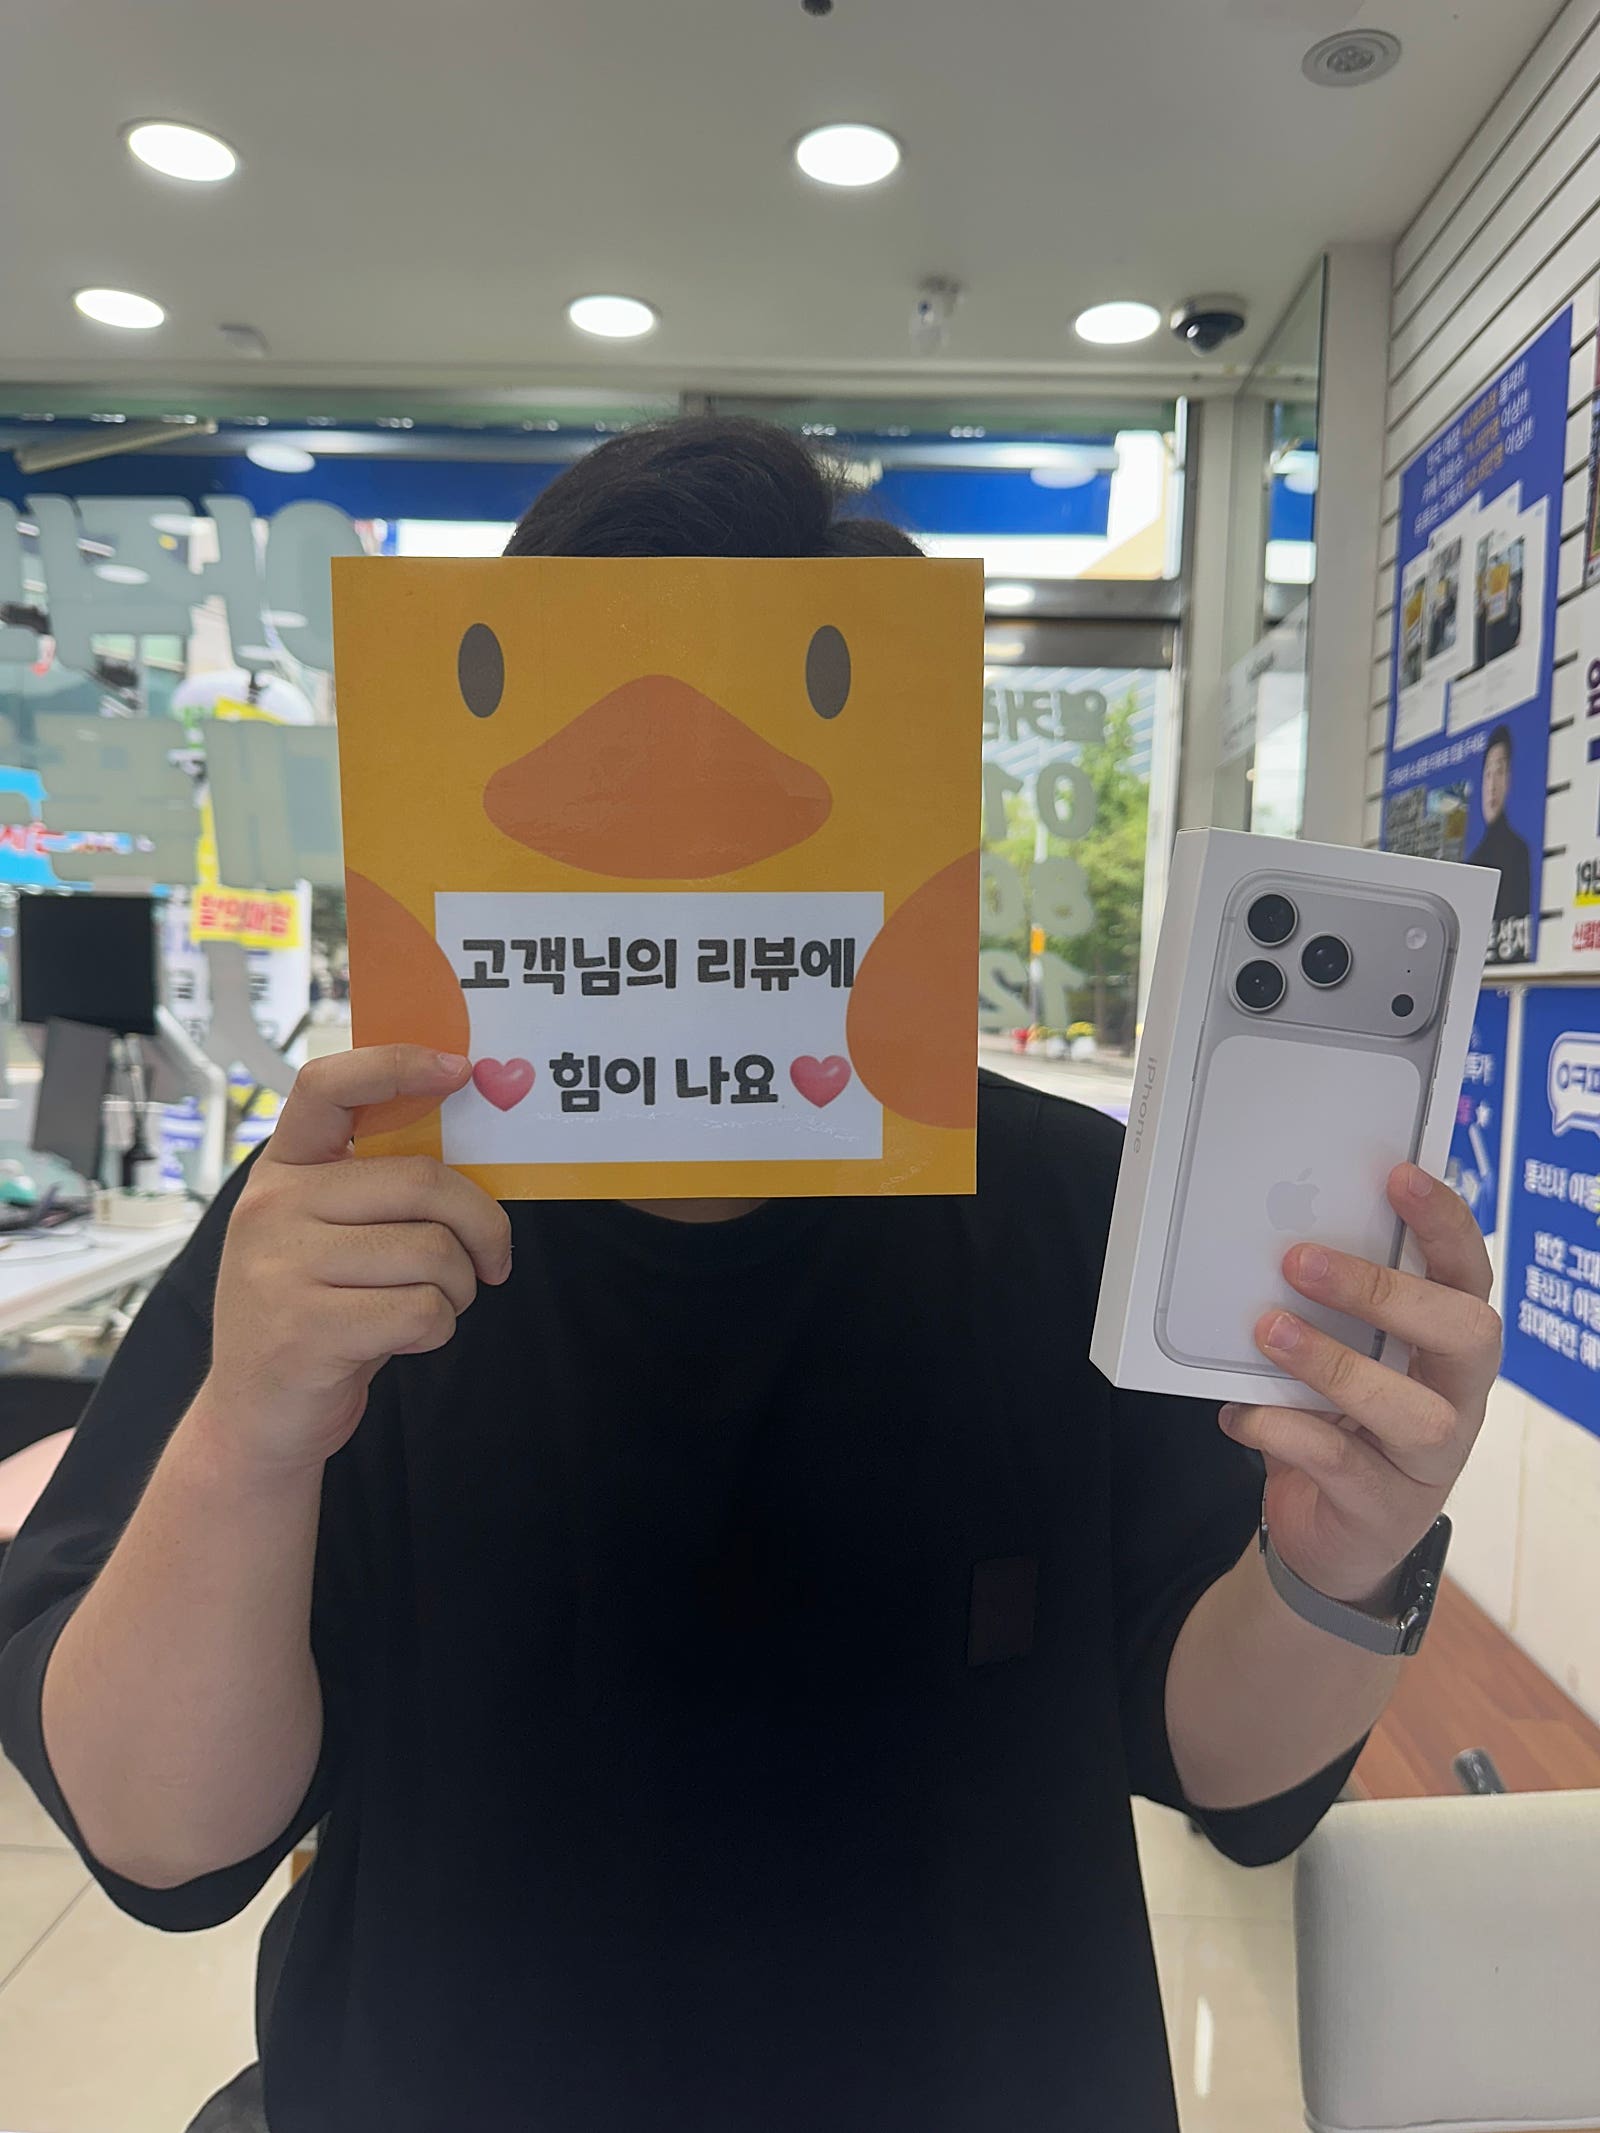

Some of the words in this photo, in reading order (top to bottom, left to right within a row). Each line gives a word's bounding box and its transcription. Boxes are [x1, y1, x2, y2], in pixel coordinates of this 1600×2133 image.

[1500, 387, 1530, 428] 이상!!
[1503, 415, 1535, 455] 이상!!
[459, 937, 677, 996] 고객님의
[697, 937, 856, 992] 리뷰에
[549, 1052, 657, 1113] 힘이
[675, 1053, 779, 1106] 나요
[1134, 1056, 1157, 1153] iPhone
[1534, 1230, 1567, 1274] 번호
